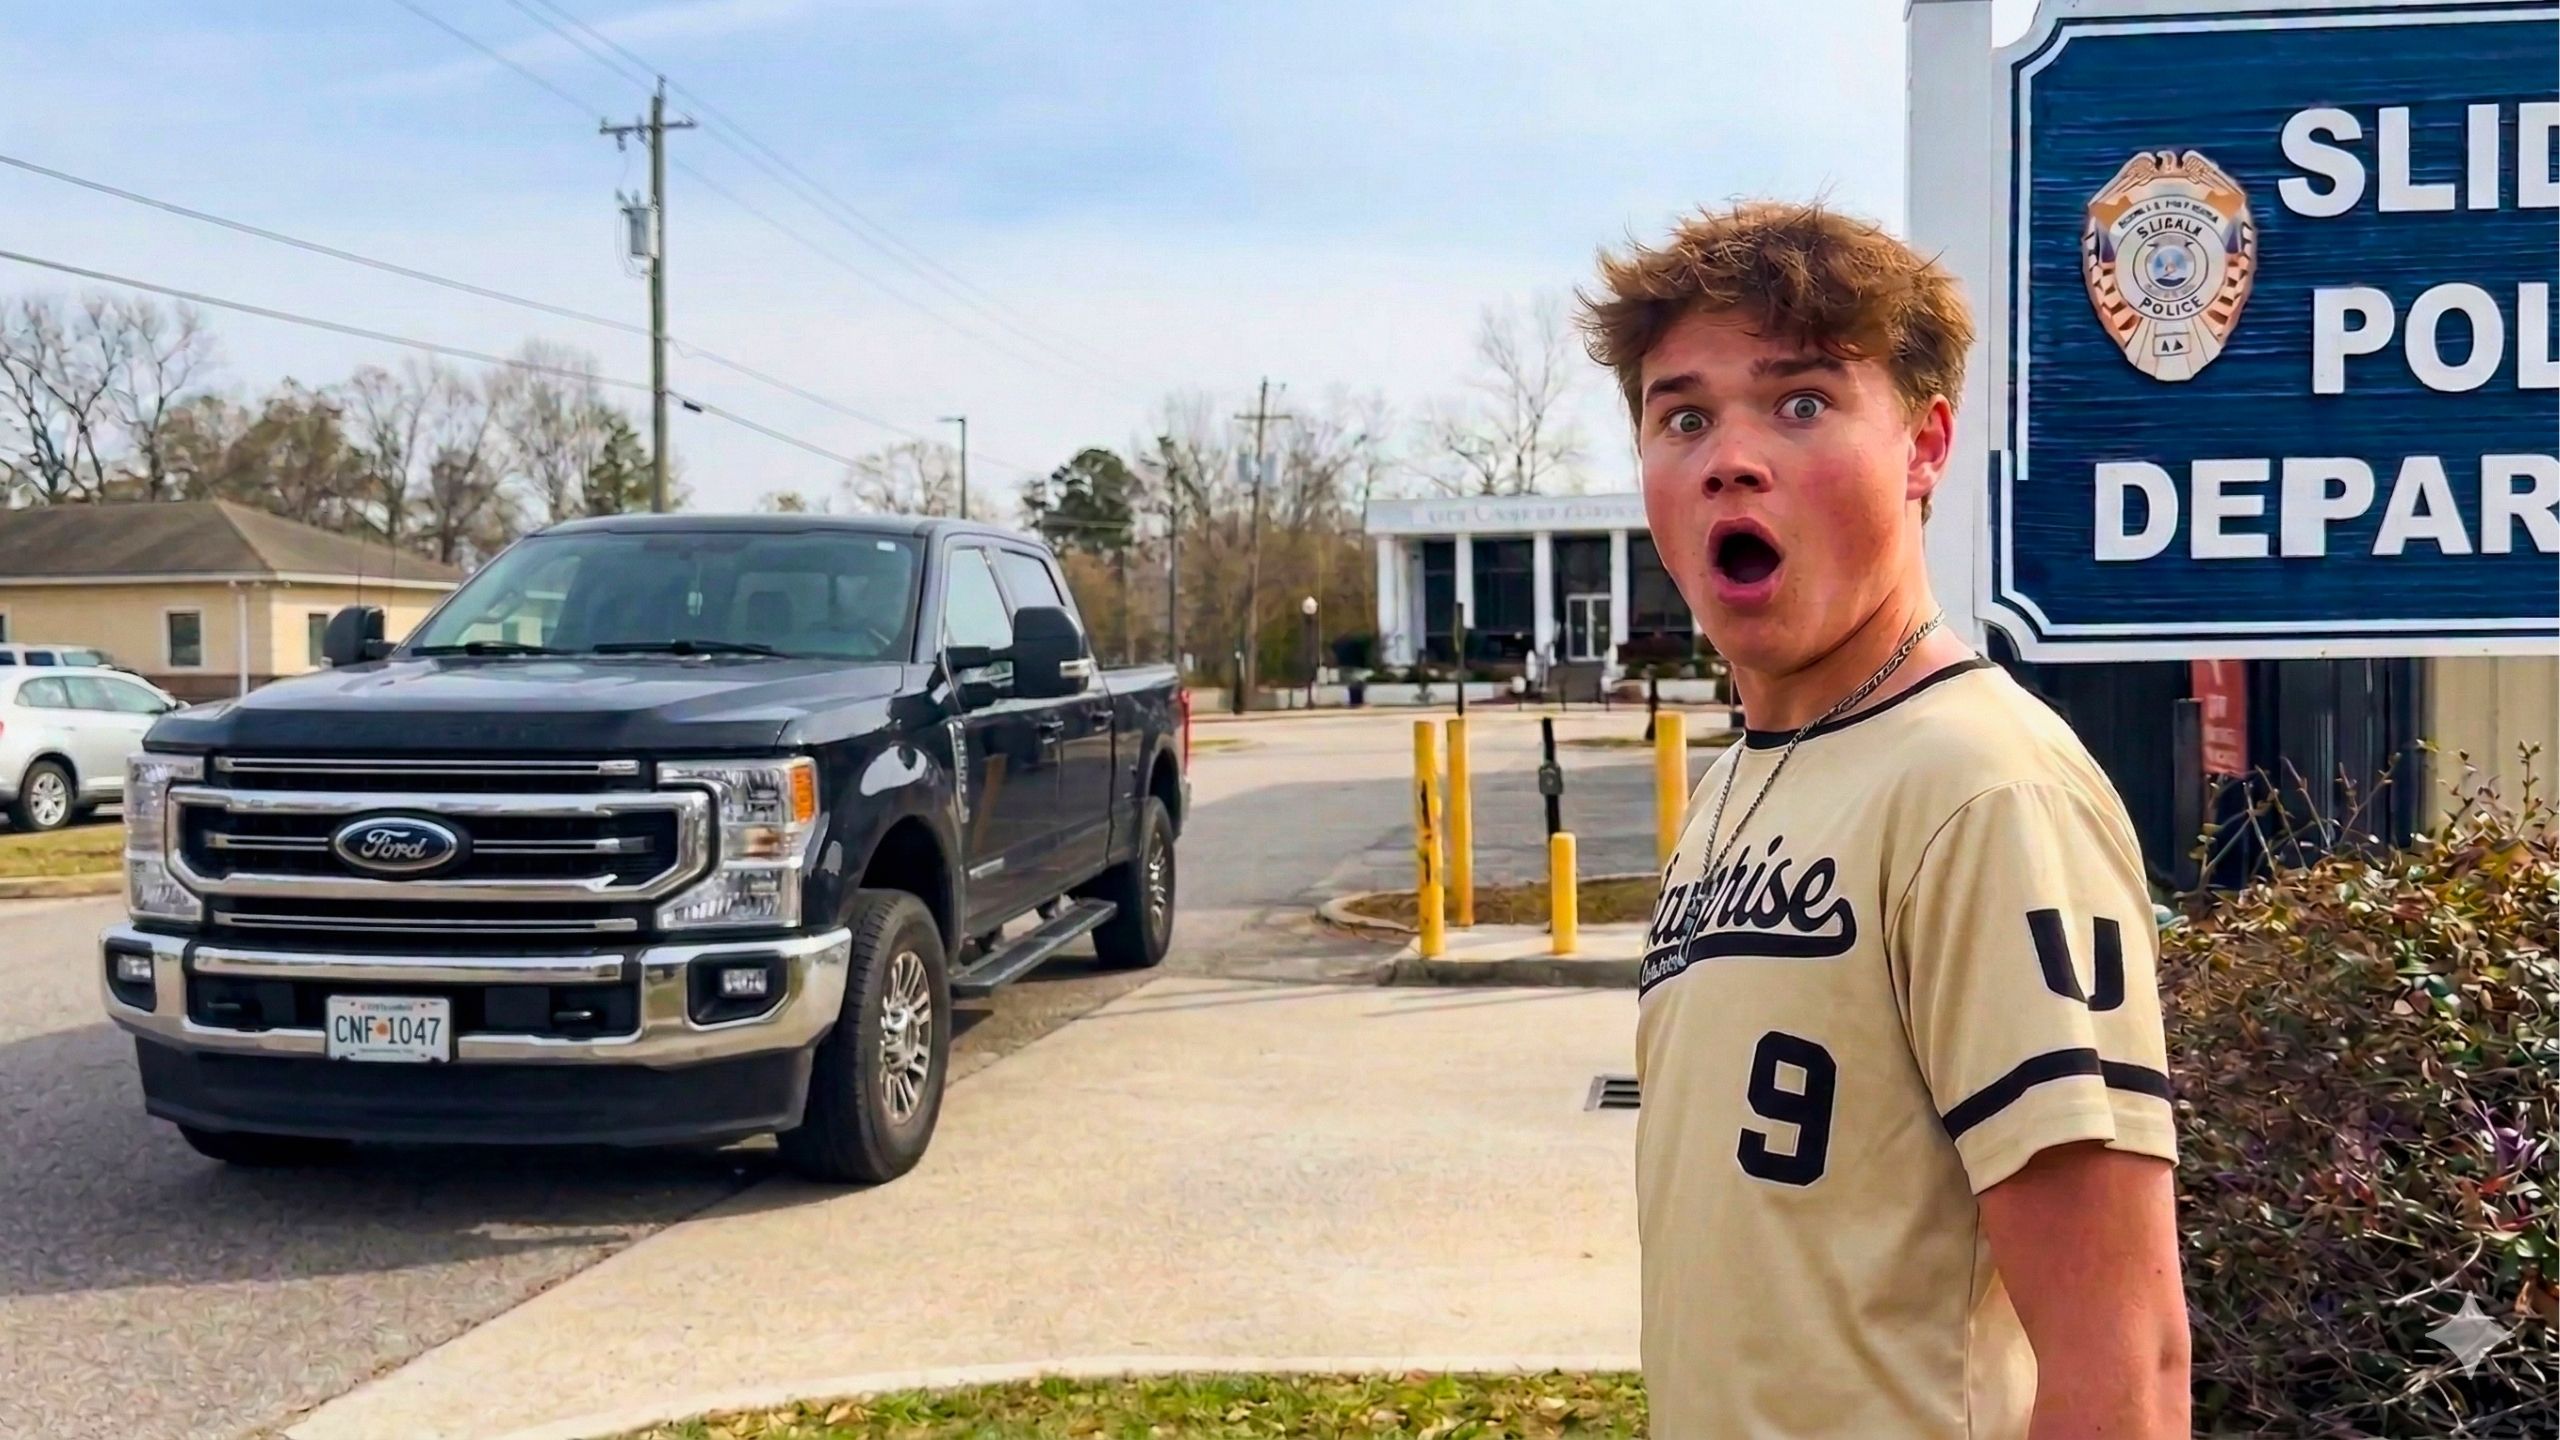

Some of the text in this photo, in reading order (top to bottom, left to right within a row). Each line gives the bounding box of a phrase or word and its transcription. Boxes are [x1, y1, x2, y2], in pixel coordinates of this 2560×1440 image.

[2138, 295, 2204, 316] POLICE
[2094, 454, 2560, 562] DEPAR
[361, 829, 428, 859] Ford
[387, 1016, 442, 1046] 1047
[1736, 1029, 1838, 1188] 9
